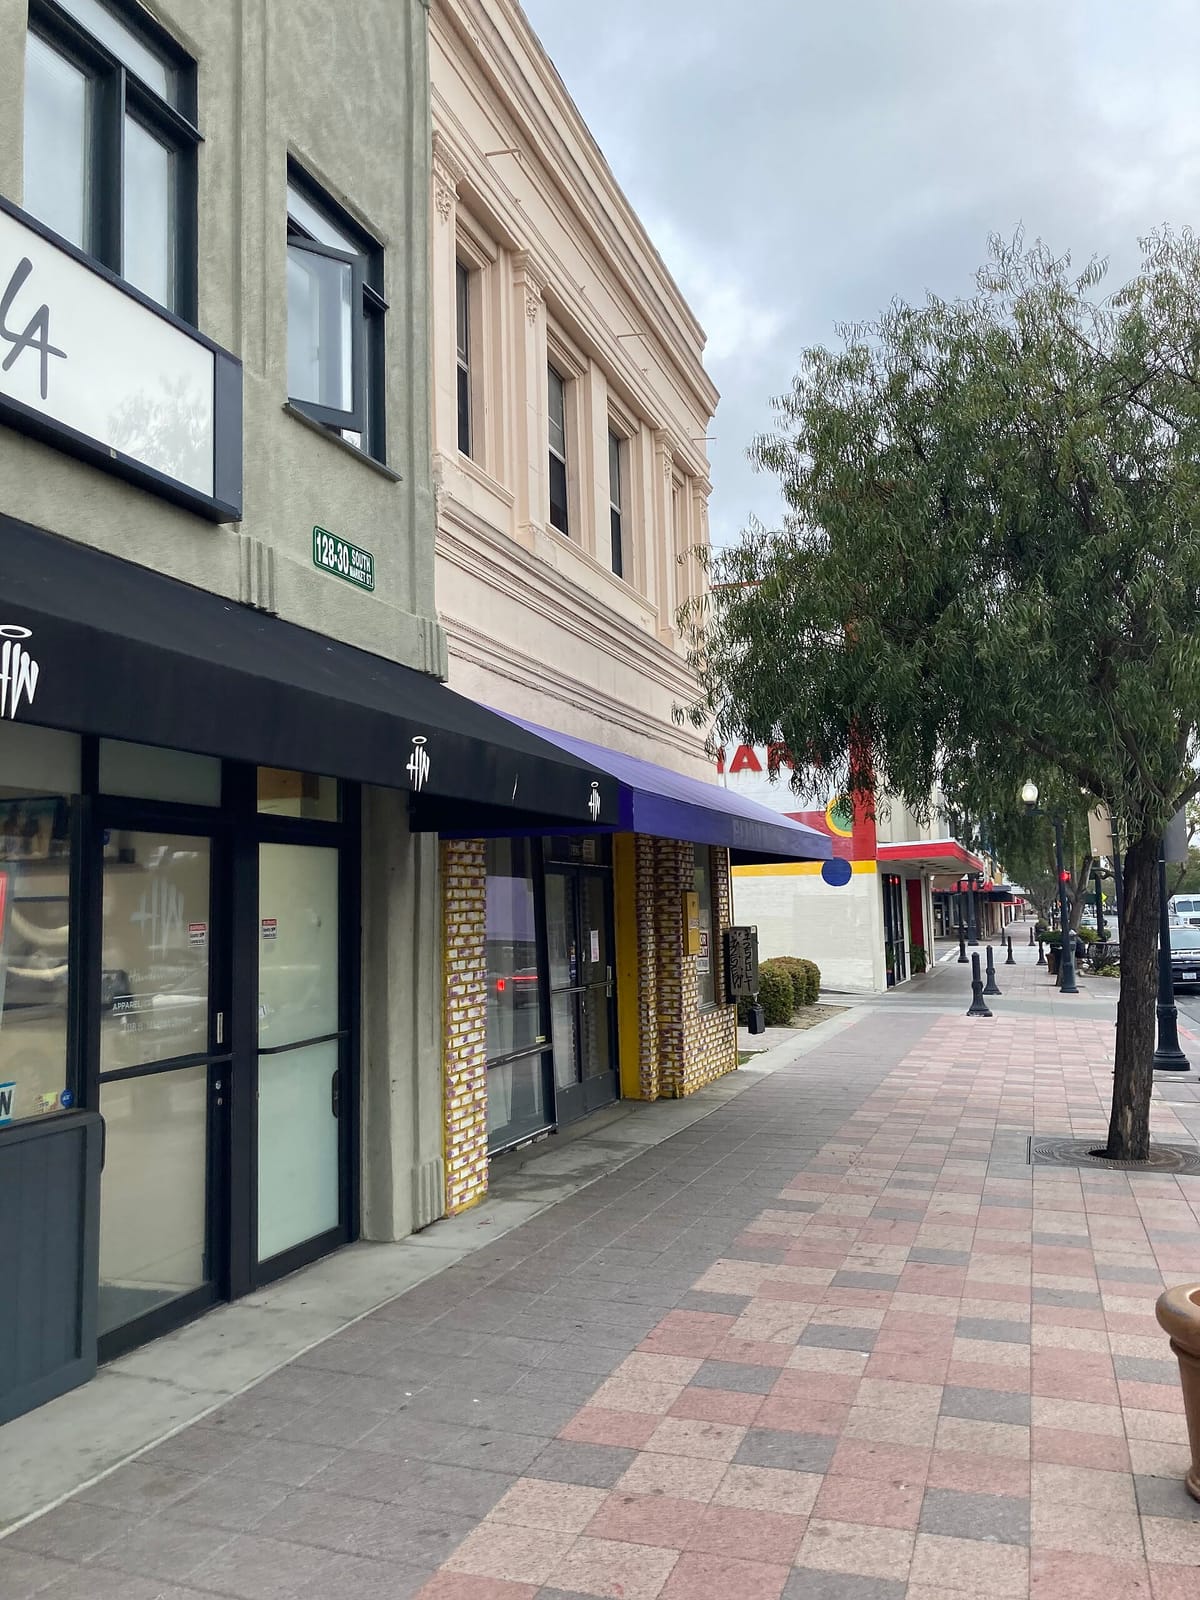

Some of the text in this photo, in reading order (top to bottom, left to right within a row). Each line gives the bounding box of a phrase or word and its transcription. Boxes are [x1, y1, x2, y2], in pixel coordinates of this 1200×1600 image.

[316, 531, 350, 575] 128-30
[351, 548, 371, 573] SOUTH
[112, 1000, 143, 1012] APPAREL
